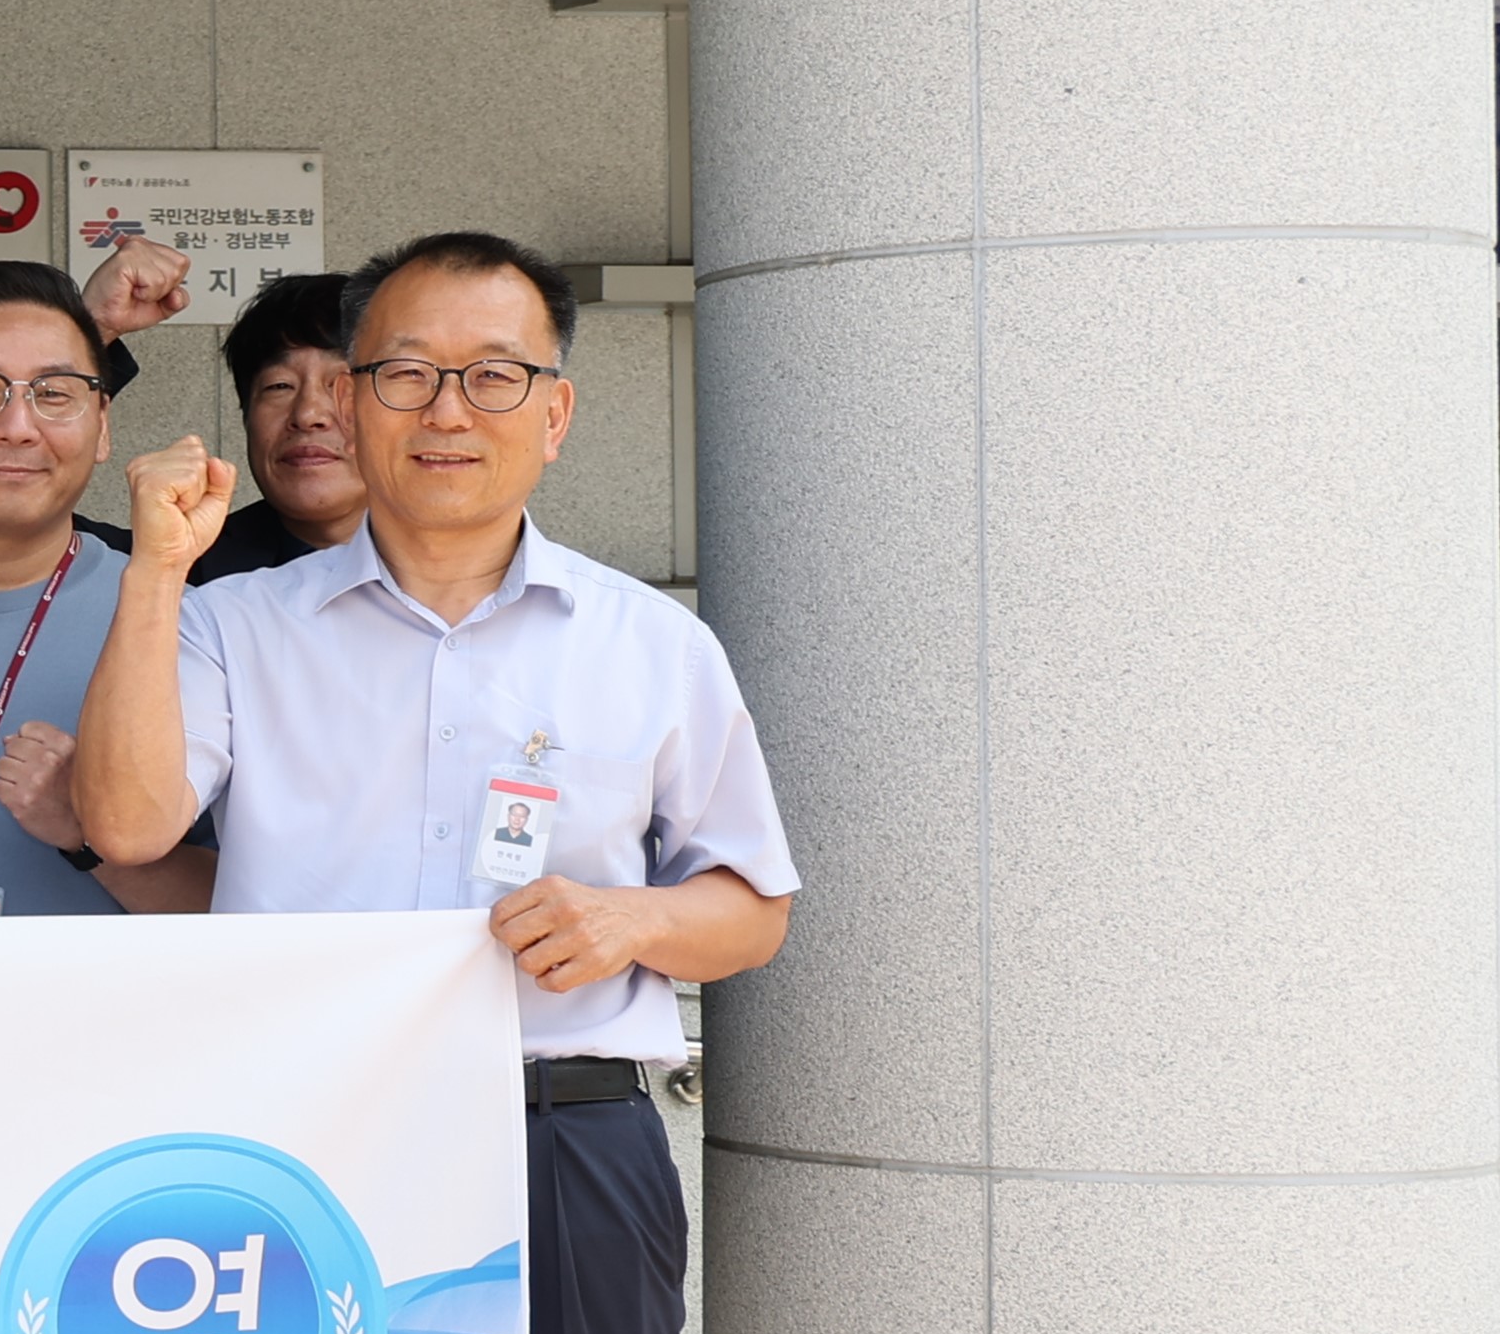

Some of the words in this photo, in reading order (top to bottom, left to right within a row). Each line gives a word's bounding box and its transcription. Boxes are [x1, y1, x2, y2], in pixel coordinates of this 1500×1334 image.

[149, 208, 315, 227] 국민건강보험노동조합
[173, 232, 207, 249] 울산
[225, 231, 291, 249] 경남본부
